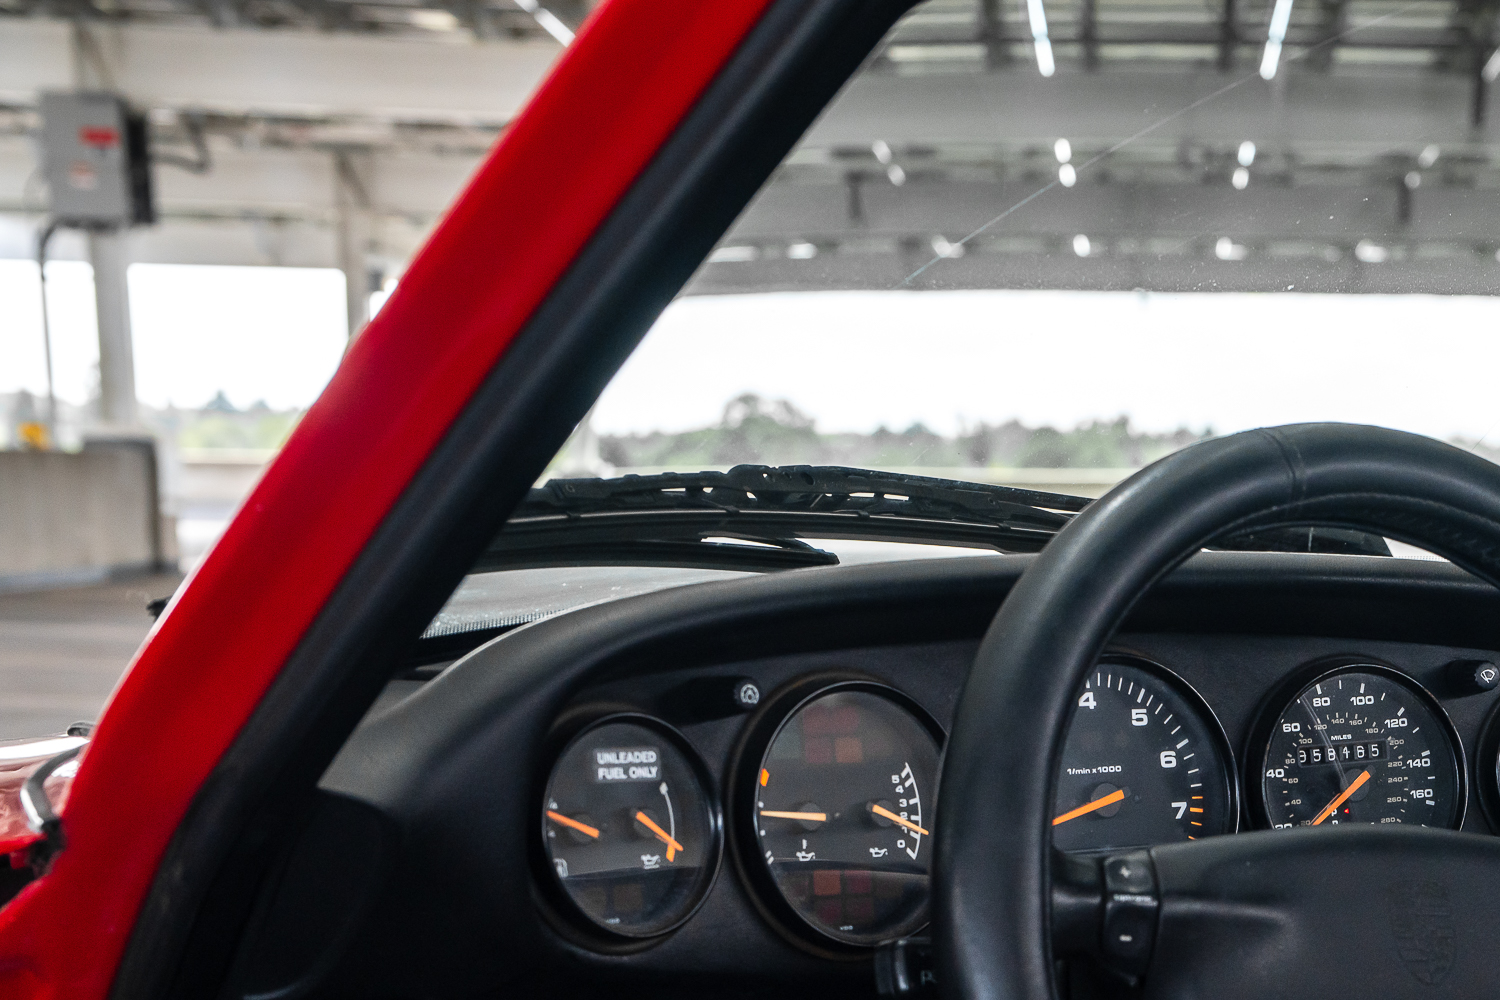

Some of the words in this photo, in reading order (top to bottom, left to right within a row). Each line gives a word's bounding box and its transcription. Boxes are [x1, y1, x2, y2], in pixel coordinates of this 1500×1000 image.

[1078, 692, 1097, 709] 4
[1313, 697, 1331, 707] 80
[1350, 695, 1375, 706] 100
[1131, 708, 1149, 727] 5
[1282, 723, 1300, 733] 60
[1384, 718, 1408, 728] 120
[596, 750, 658, 766] UNLEADED
[1160, 750, 1177, 769] 6
[1406, 758, 1431, 769] 140
[598, 766, 628, 780] FUEL
[629, 766, 659, 779] ONLY
[1066, 767, 1091, 775] 1/min
[1266, 768, 1285, 778] 40
[891, 774, 900, 784] 5
[895, 785, 904, 794] 4
[1409, 788, 1434, 799] 160
[899, 798, 908, 808] 3
[1170, 801, 1188, 820] 7
[897, 839, 906, 849] 0
